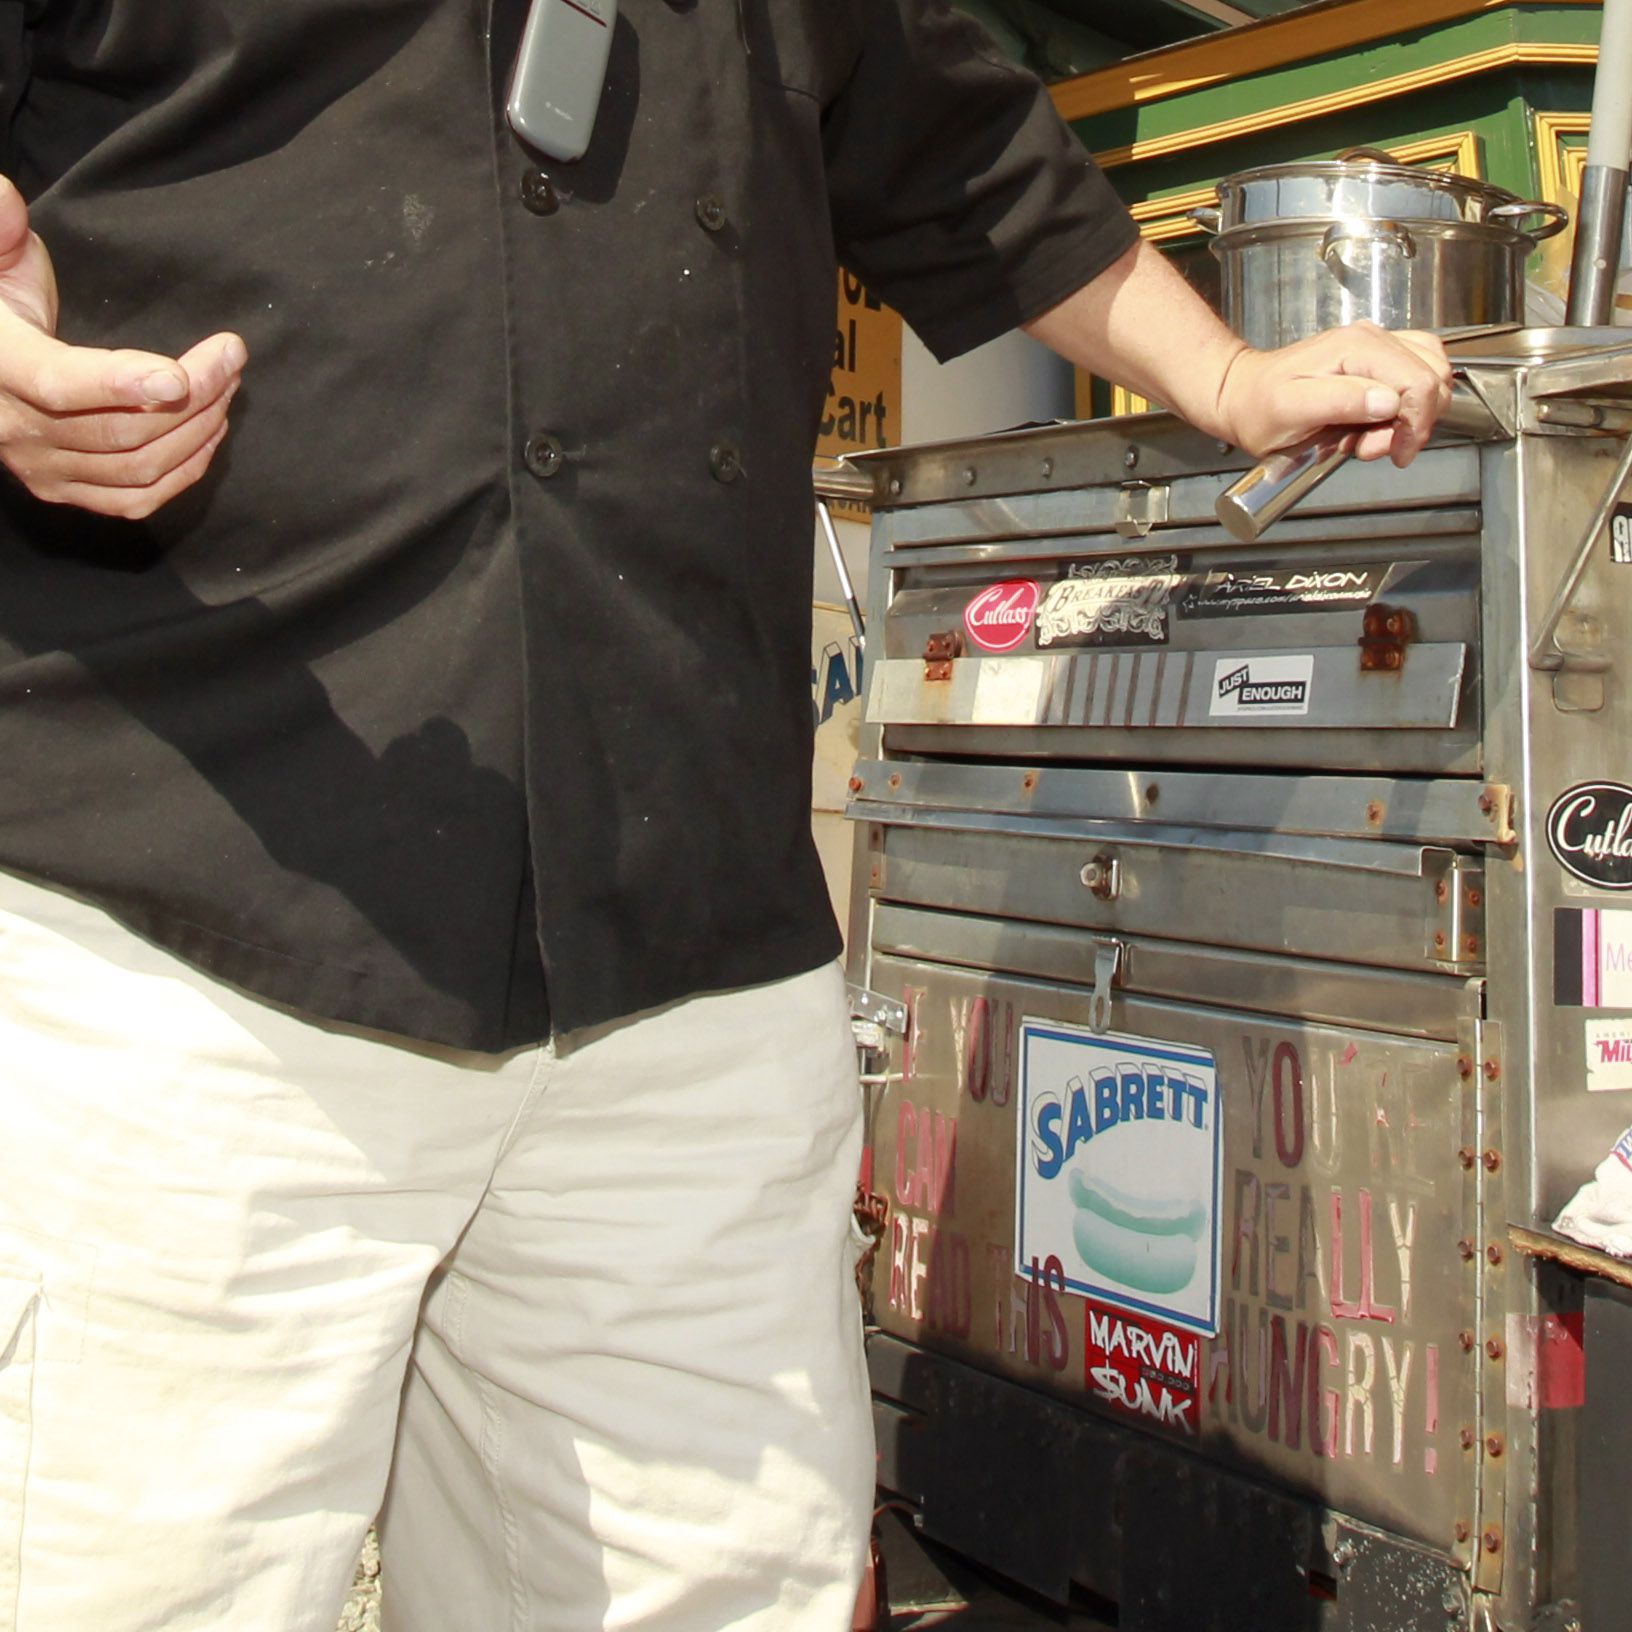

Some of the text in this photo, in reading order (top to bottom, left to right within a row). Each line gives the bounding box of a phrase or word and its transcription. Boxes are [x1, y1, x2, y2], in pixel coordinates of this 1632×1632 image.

[1219, 668, 1249, 695] JUST
[1241, 685, 1304, 701] ENOUGH
[895, 1100, 958, 1216] CAN
[1031, 1062, 1210, 1180] SABRETT
[888, 1210, 970, 1335] READ
[1231, 1169, 1416, 1324] REALLY
[1088, 1309, 1197, 1379] MARVIN
[1207, 1300, 1440, 1476] HUNGRY!
